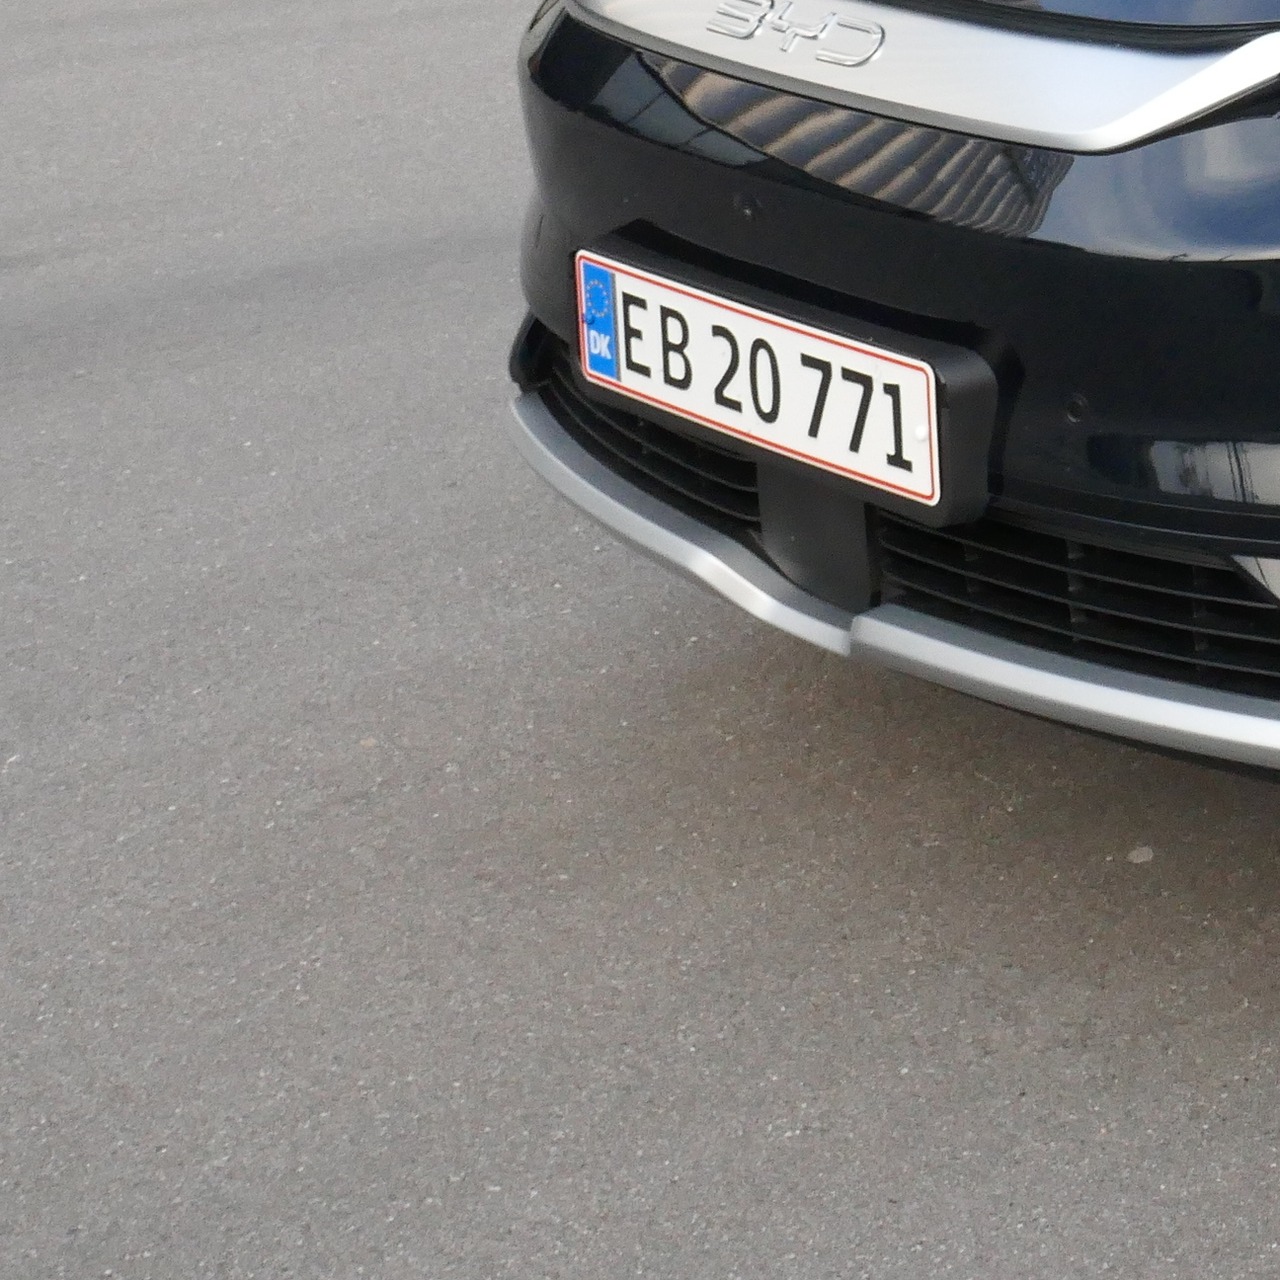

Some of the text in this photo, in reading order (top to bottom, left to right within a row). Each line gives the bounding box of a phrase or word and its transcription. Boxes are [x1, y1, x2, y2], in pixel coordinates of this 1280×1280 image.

[589, 328, 613, 360] DK
[621, 290, 914, 473] EB 20 771
